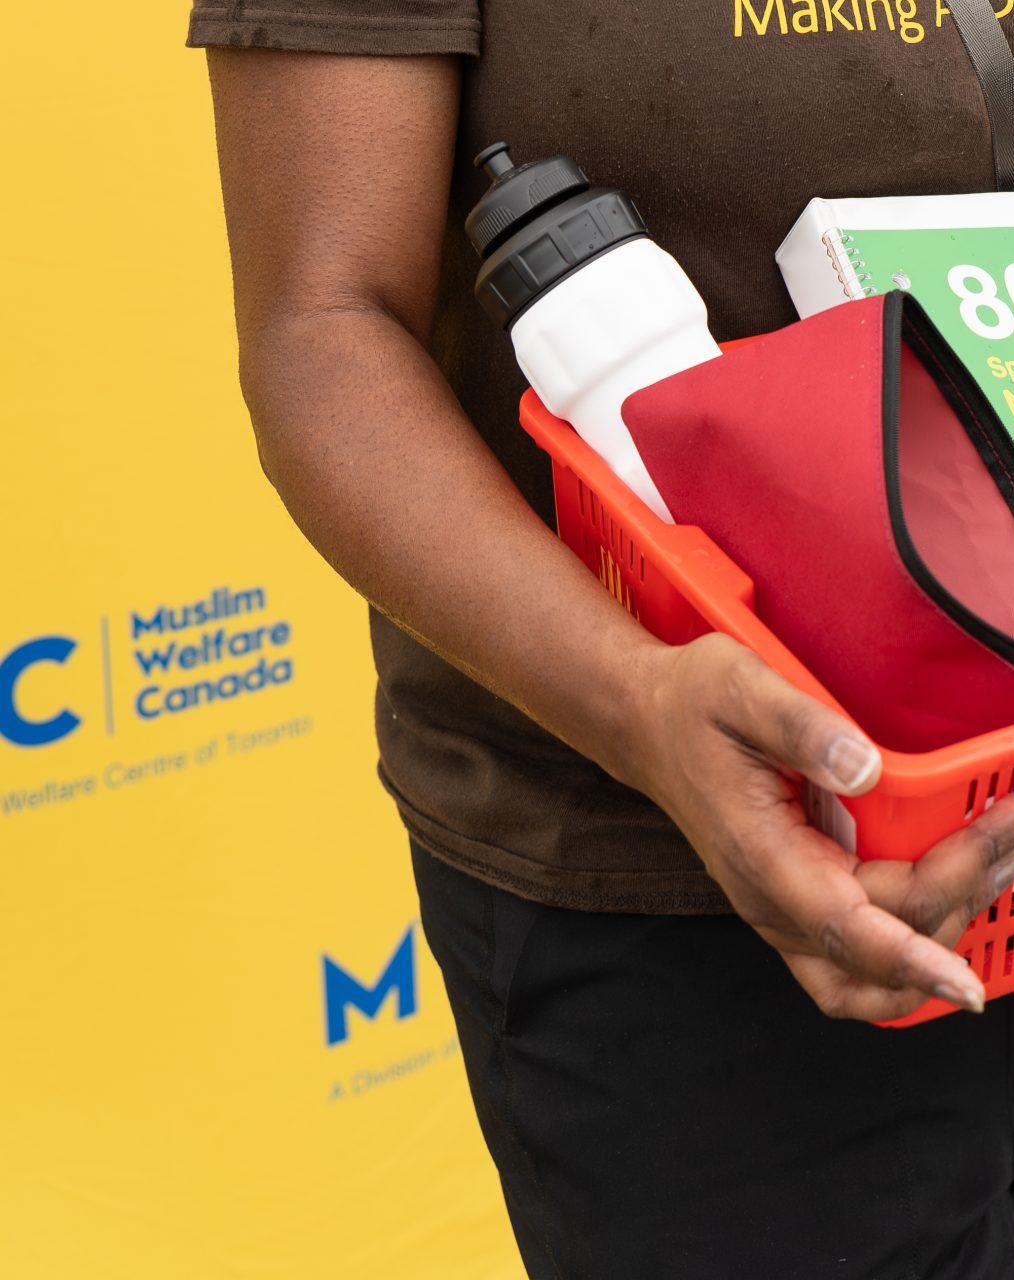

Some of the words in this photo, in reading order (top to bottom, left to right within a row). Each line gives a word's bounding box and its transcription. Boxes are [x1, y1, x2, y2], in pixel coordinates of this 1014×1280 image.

[131, 587, 265, 641] Muslim
[134, 621, 290, 676] Welfare
[135, 657, 293, 719] Canada
